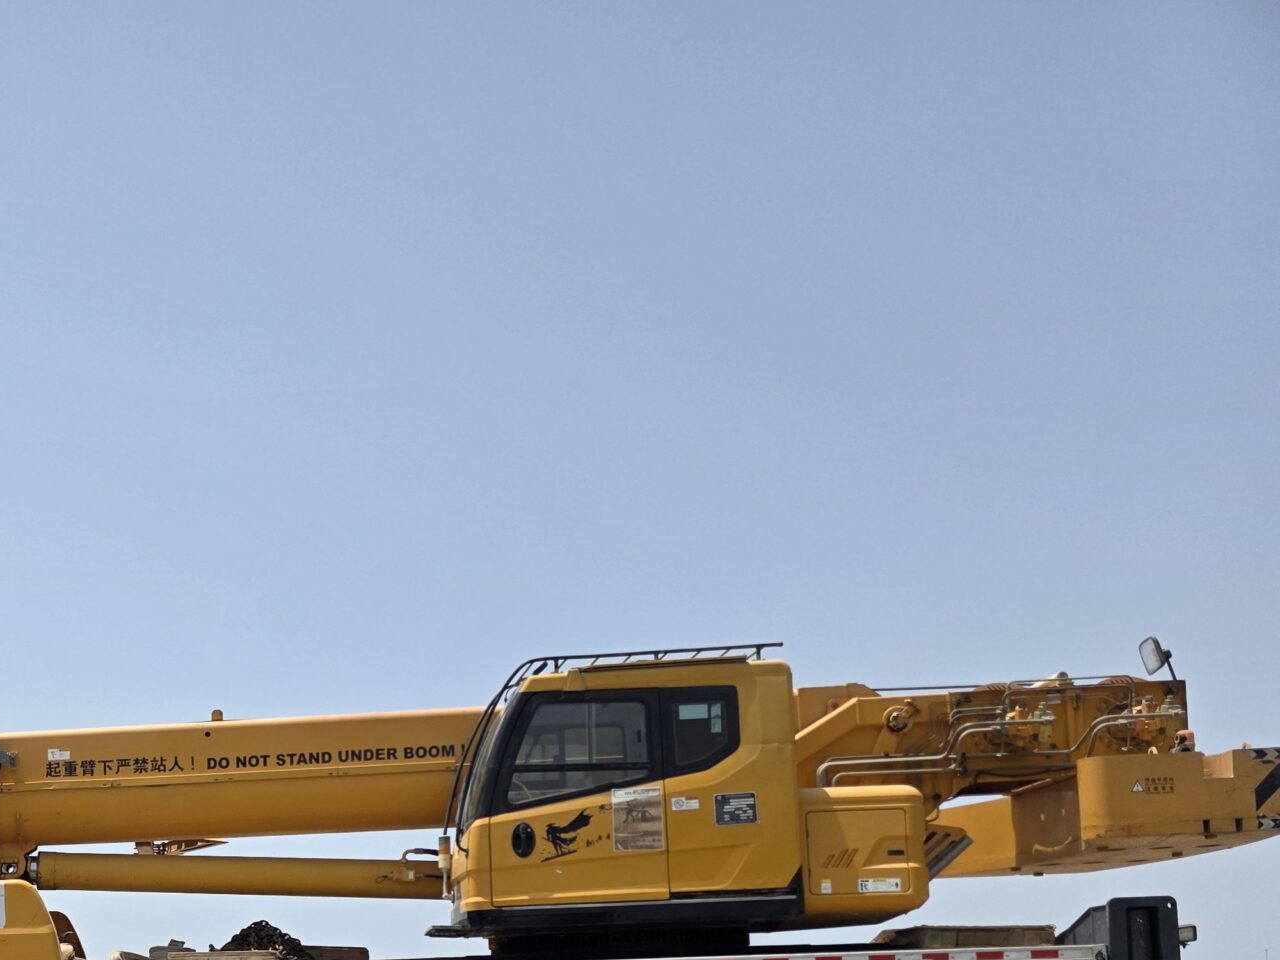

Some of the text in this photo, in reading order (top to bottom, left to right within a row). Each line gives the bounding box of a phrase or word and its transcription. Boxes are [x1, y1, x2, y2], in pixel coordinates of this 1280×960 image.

[206, 756, 230, 770] DO
[235, 754, 271, 768] NOT
[275, 751, 333, 766] STAND
[338, 747, 398, 763] UNDER
[403, 744, 456, 759] BOOM
